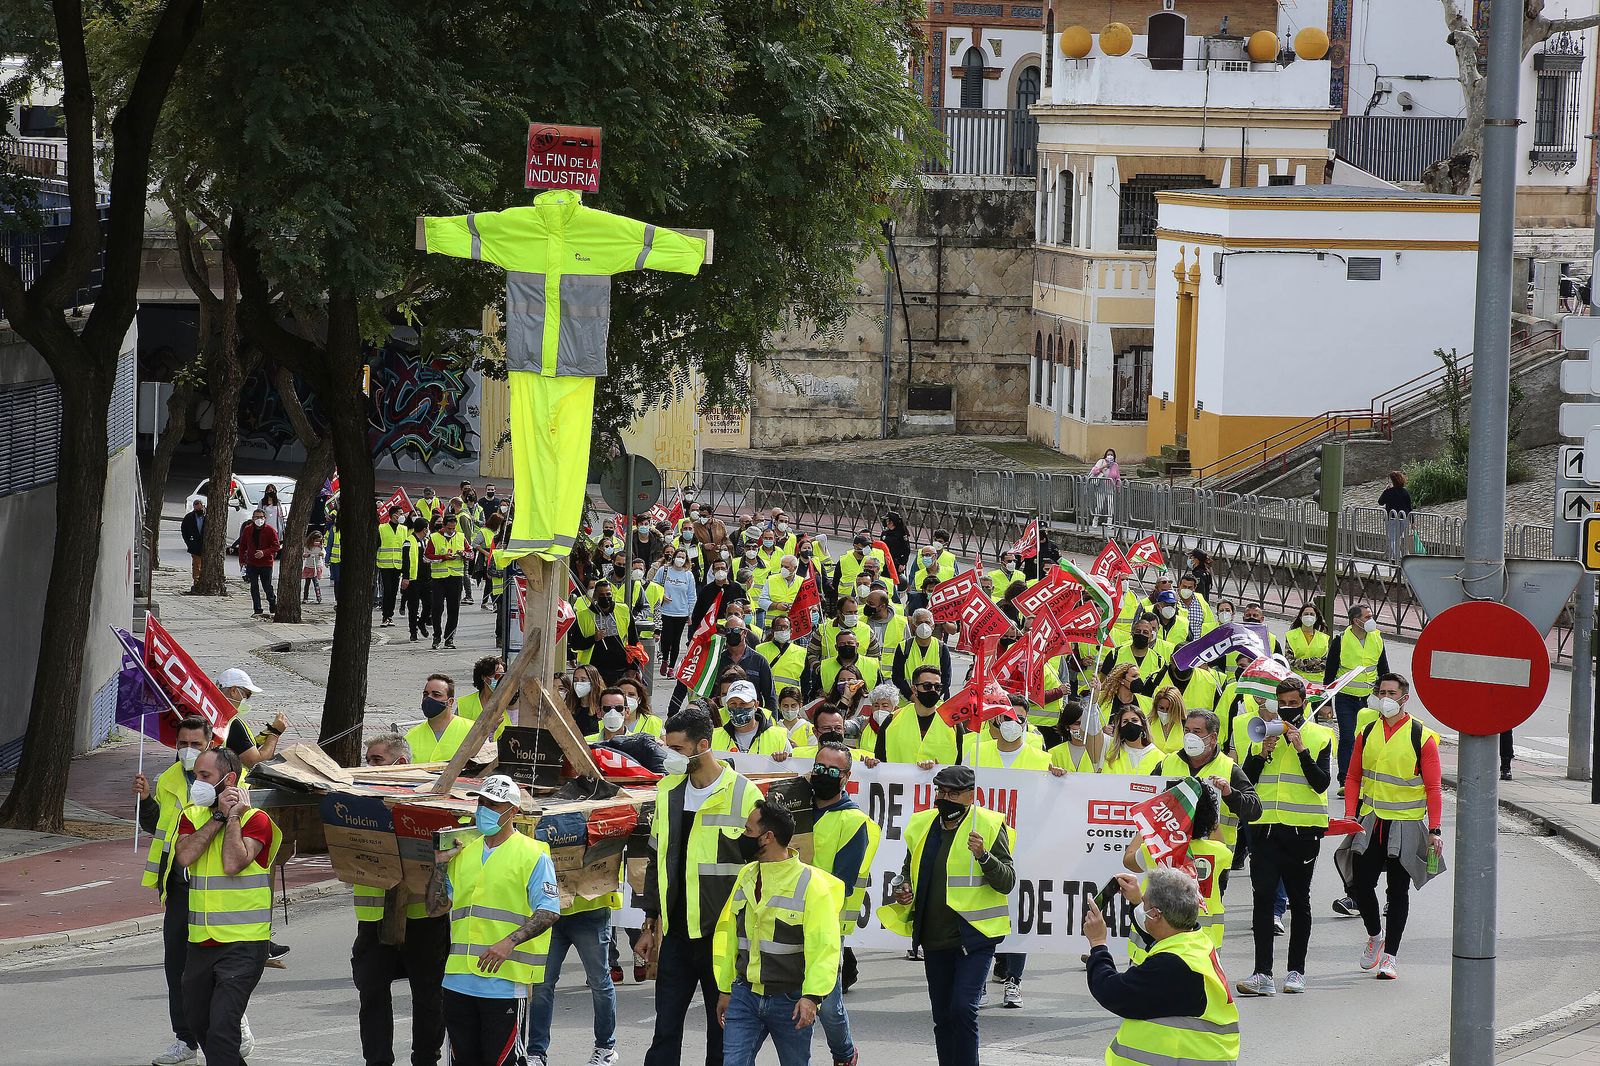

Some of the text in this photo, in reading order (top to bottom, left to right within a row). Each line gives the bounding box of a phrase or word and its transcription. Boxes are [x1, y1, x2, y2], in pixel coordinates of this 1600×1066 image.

[530, 153, 598, 169] AL FIN DE LA
[528, 169, 597, 186] INDUSTRIA
[516, 749, 546, 761] Holcm
[868, 782, 904, 841] DE
[345, 814, 379, 828] Holcim
[1150, 801, 1188, 844] Cádiz
[1086, 828, 1138, 839] constr
[1086, 842, 1131, 854] y ser
[1017, 879, 1131, 938] DE TRAB
